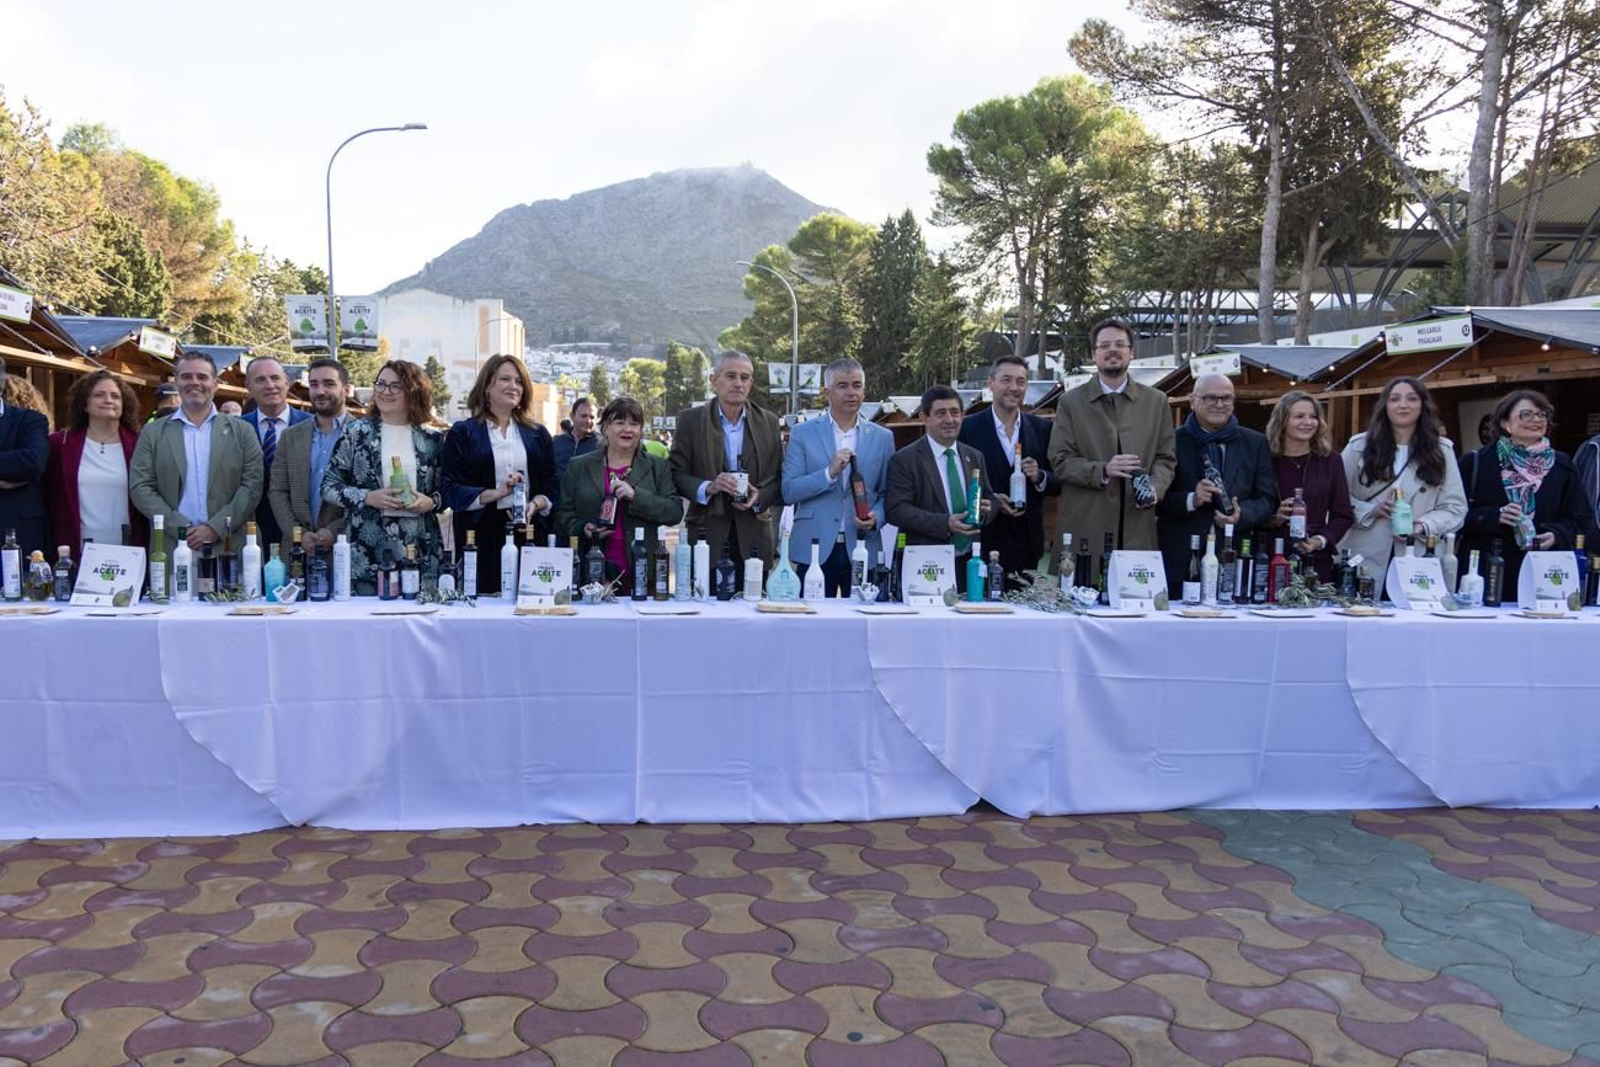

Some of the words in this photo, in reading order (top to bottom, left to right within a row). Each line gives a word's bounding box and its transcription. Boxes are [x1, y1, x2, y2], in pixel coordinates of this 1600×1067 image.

[92, 567, 127, 576] ACEITE
[531, 569, 562, 577] ACEITE
[917, 567, 945, 576] ACEITE
